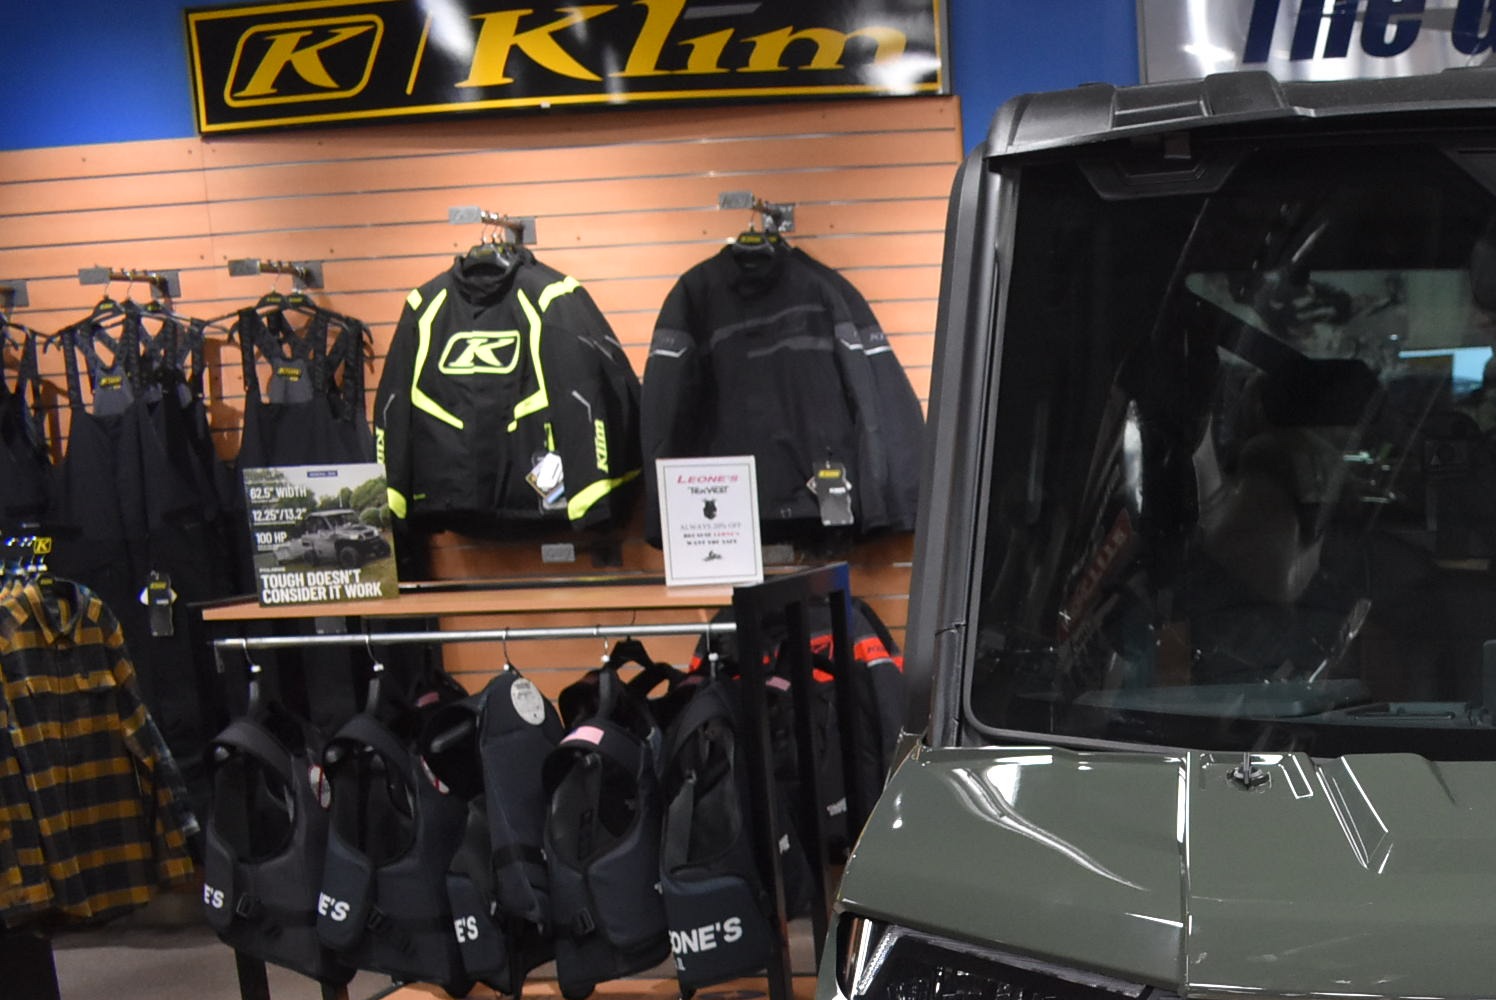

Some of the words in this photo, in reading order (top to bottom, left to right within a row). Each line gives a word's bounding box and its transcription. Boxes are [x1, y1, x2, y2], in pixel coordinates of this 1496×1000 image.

[232, 25, 376, 97] K
[447, 336, 517, 368] K
[276, 486, 307, 498] WIDTH
[256, 532, 272, 544] 100
[274, 531, 287, 543] HP
[260, 571, 305, 589] TOUGH
[307, 569, 361, 586] DOESN'T
[262, 585, 327, 603] CONSIDER
[329, 584, 342, 599] IT
[345, 582, 382, 597] WORK
